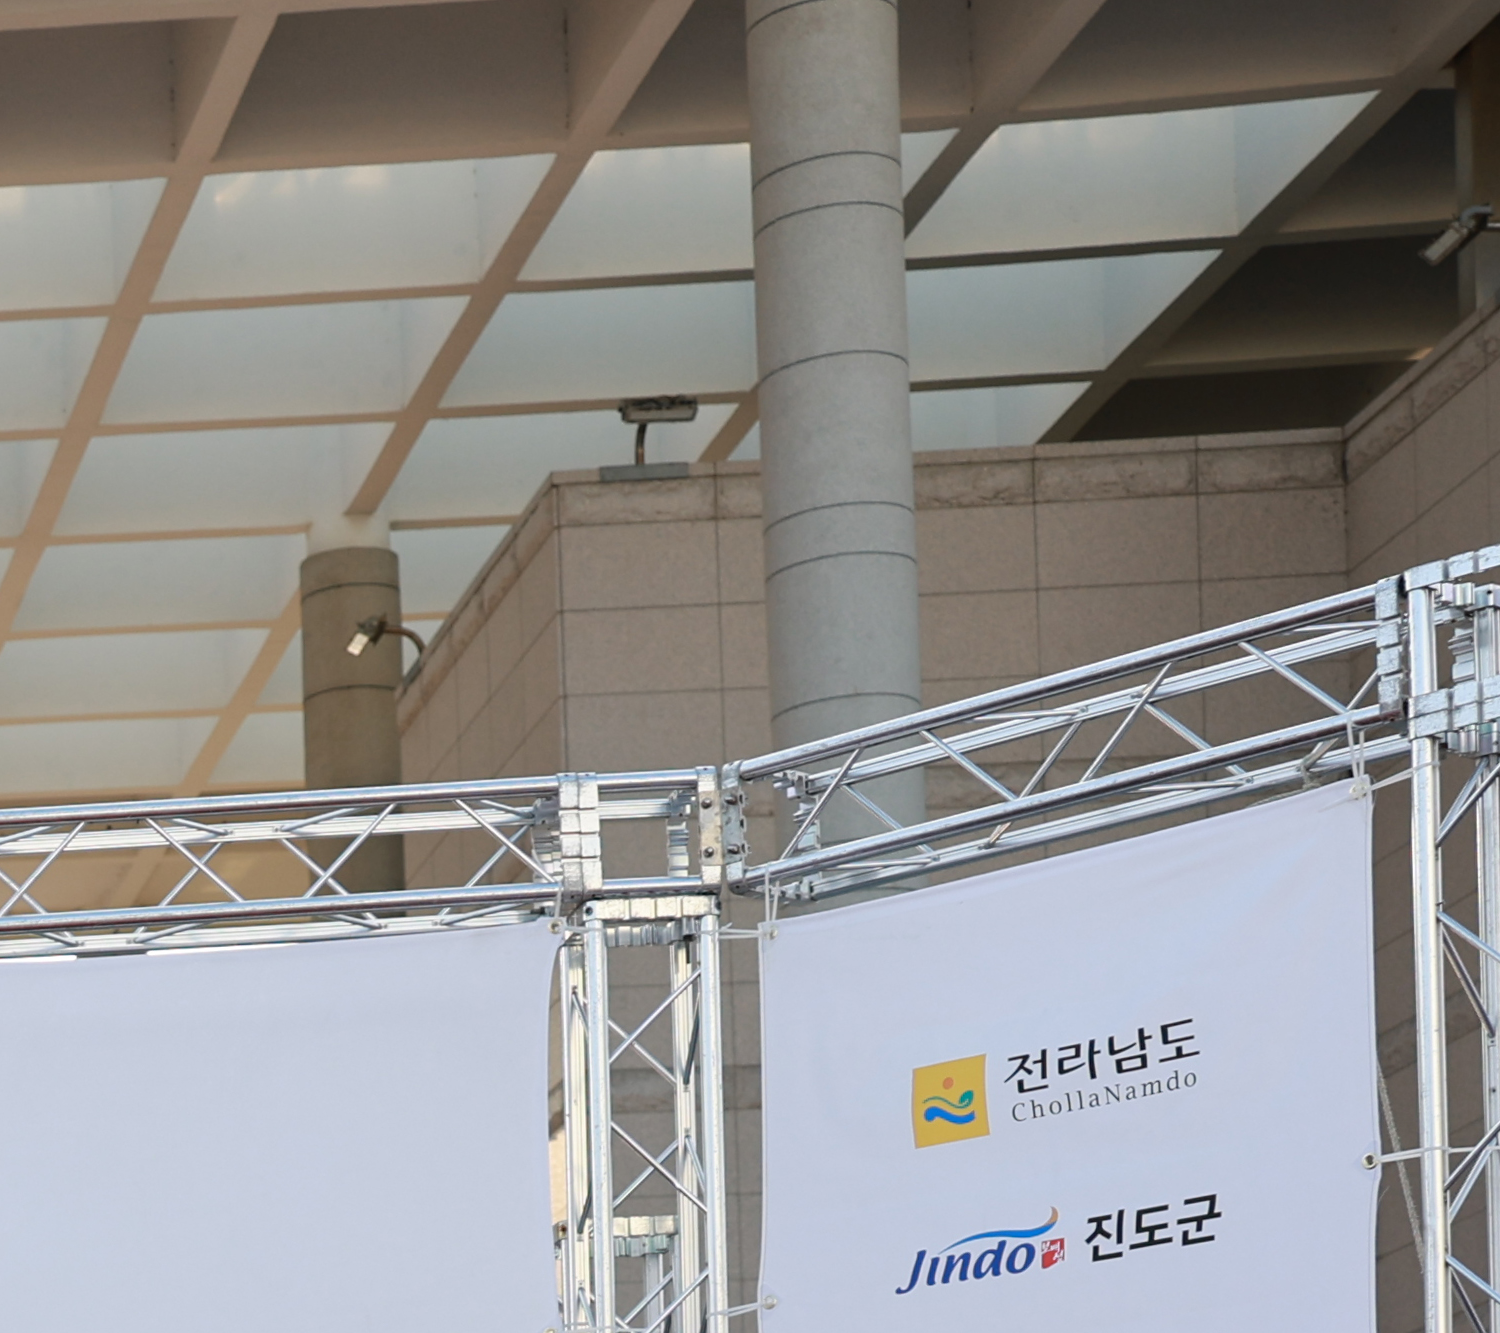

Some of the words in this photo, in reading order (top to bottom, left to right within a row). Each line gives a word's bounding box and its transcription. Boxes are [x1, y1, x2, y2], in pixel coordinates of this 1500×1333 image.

[1004, 1018, 1200, 1094] 전라남도
[1011, 1070, 1198, 1122] ChollaNamdo
[1084, 1193, 1222, 1262] 진도군
[895, 1239, 1036, 1296] Jindo
